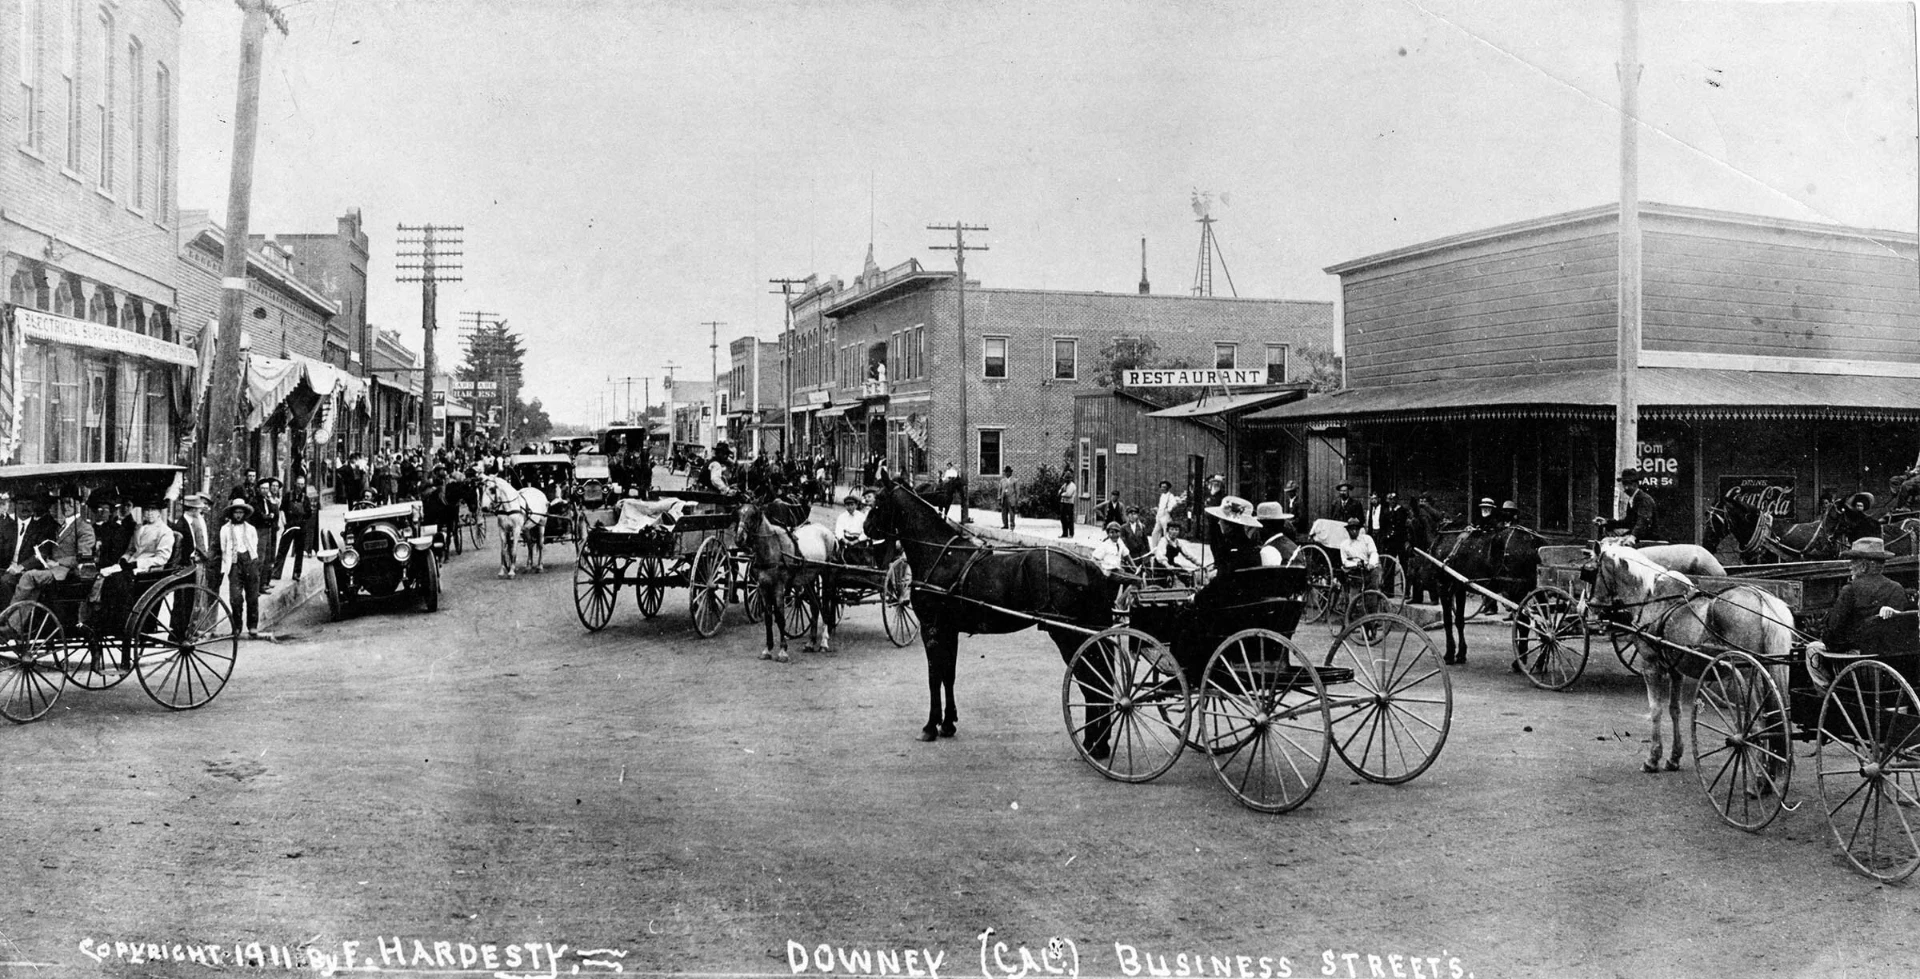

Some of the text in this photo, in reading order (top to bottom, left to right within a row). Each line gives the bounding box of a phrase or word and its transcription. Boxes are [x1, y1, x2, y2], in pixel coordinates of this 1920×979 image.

[24, 313, 78, 337] ELECTRICAL
[82, 324, 119, 344] SUPPLIES
[1129, 370, 1261, 385] RESTAURANT
[453, 390, 497, 398] HARESS
[1637, 441, 1663, 457] Tom
[1635, 457, 1678, 473] eene
